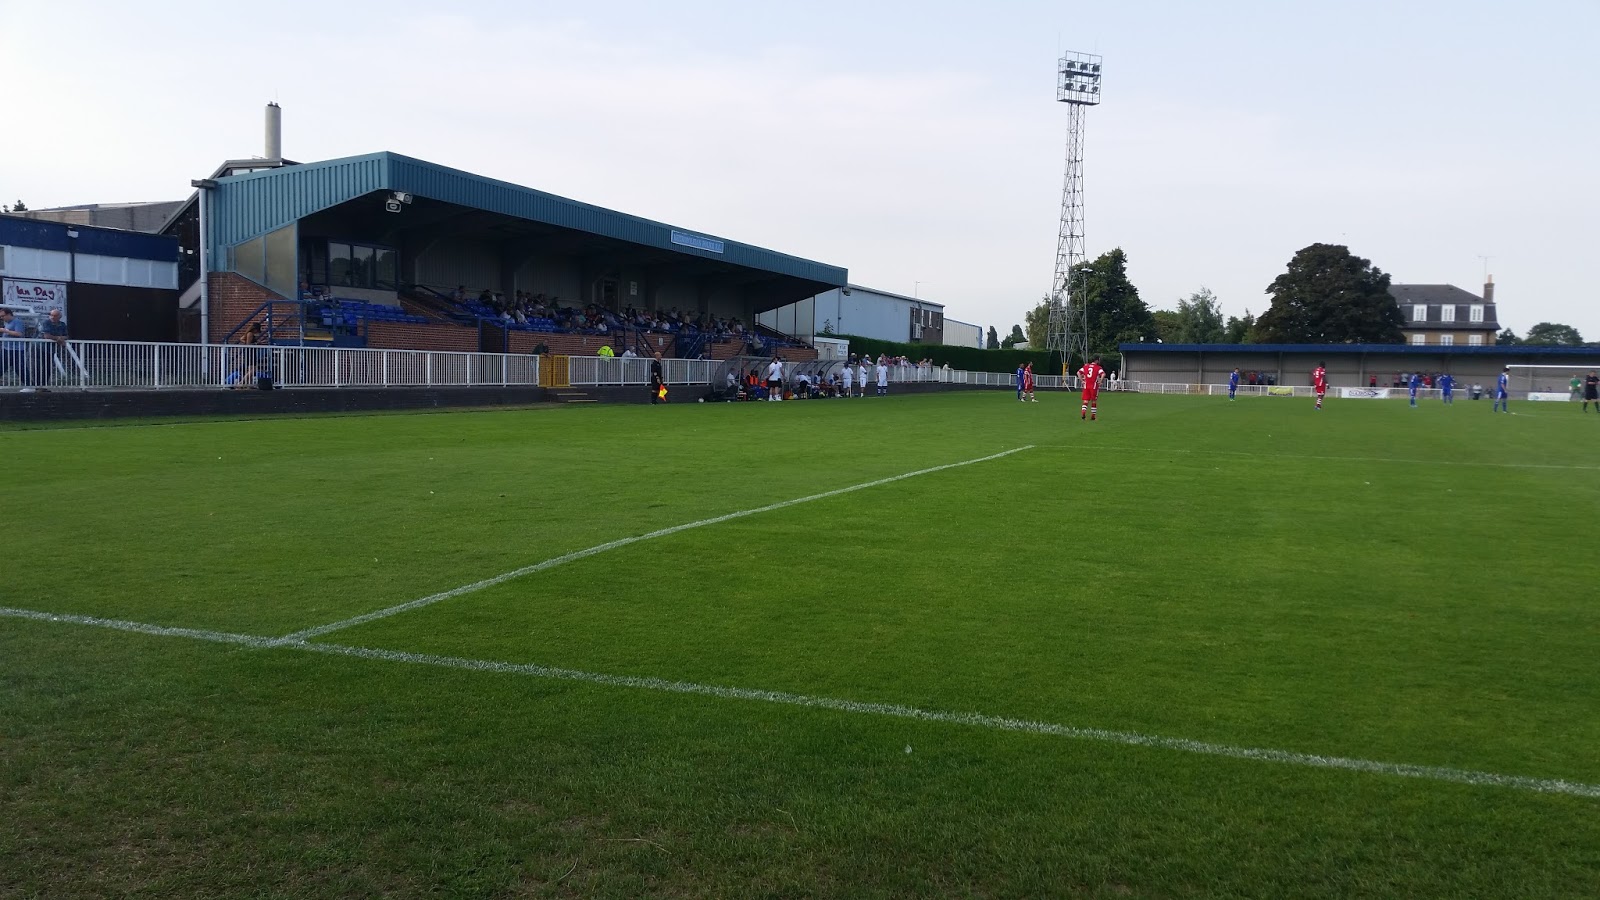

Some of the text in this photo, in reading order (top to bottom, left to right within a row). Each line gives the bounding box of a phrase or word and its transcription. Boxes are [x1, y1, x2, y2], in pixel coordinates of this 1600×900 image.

[16, 286, 54, 300] Ian Day
[1087, 368, 1093, 378] 3
